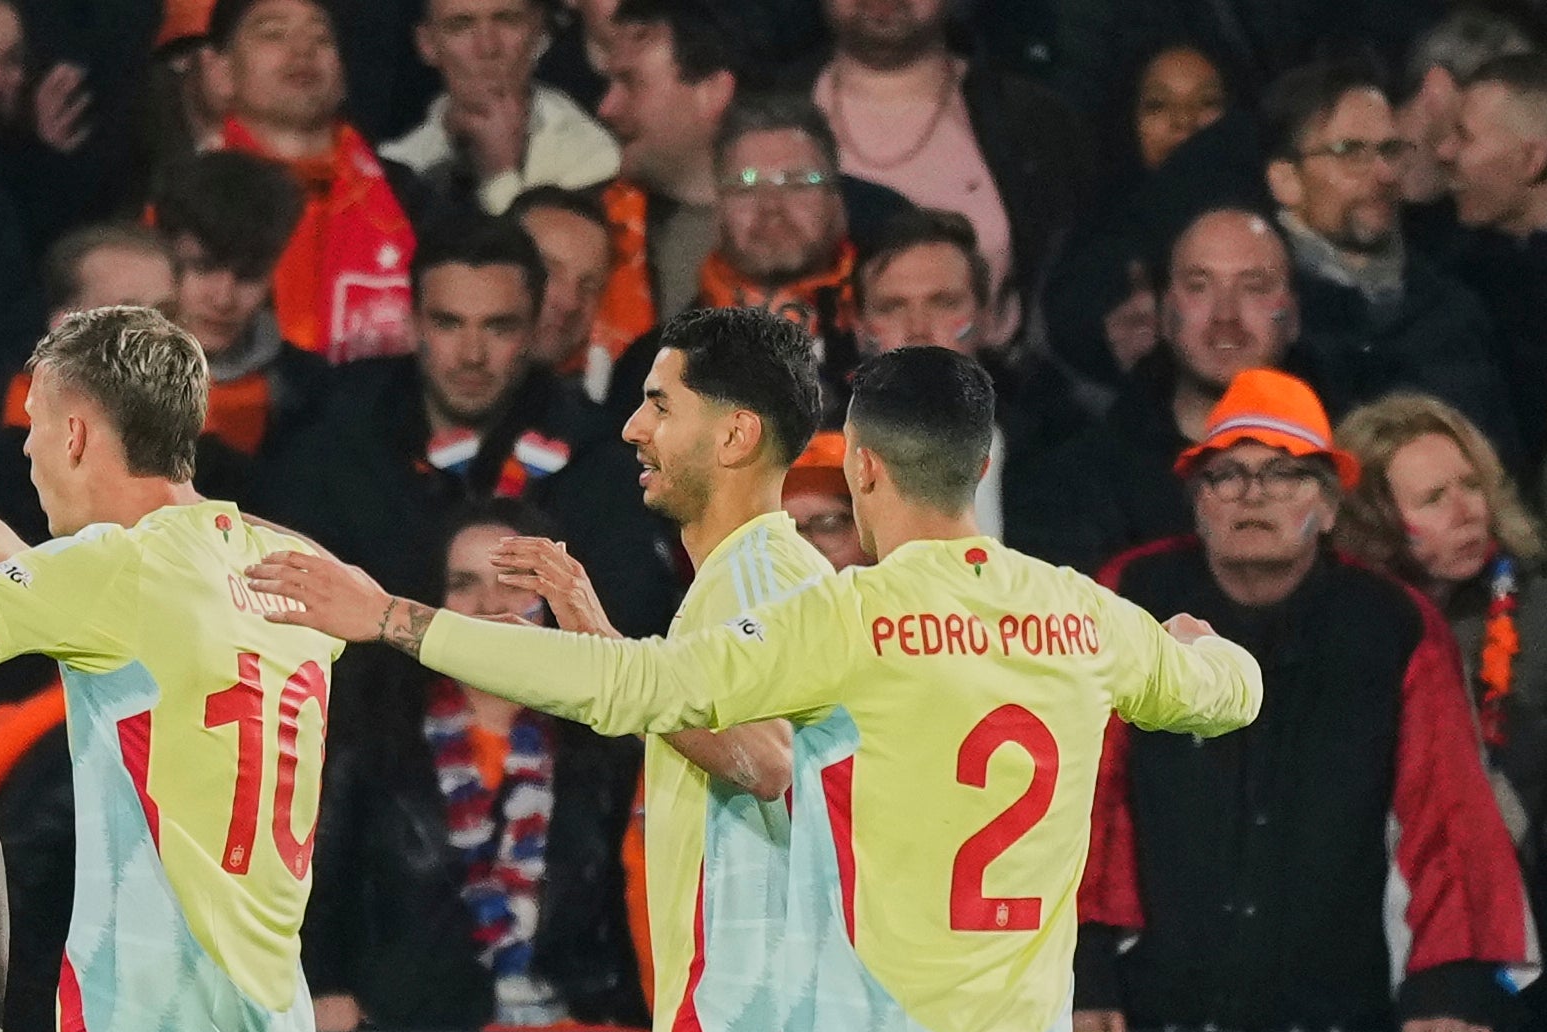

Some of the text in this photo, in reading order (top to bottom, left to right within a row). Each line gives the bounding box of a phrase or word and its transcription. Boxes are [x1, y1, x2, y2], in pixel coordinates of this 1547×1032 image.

[872, 613, 1099, 656] PEDRO PORRO
[204, 652, 328, 881] 10
[951, 704, 1060, 931] 2
